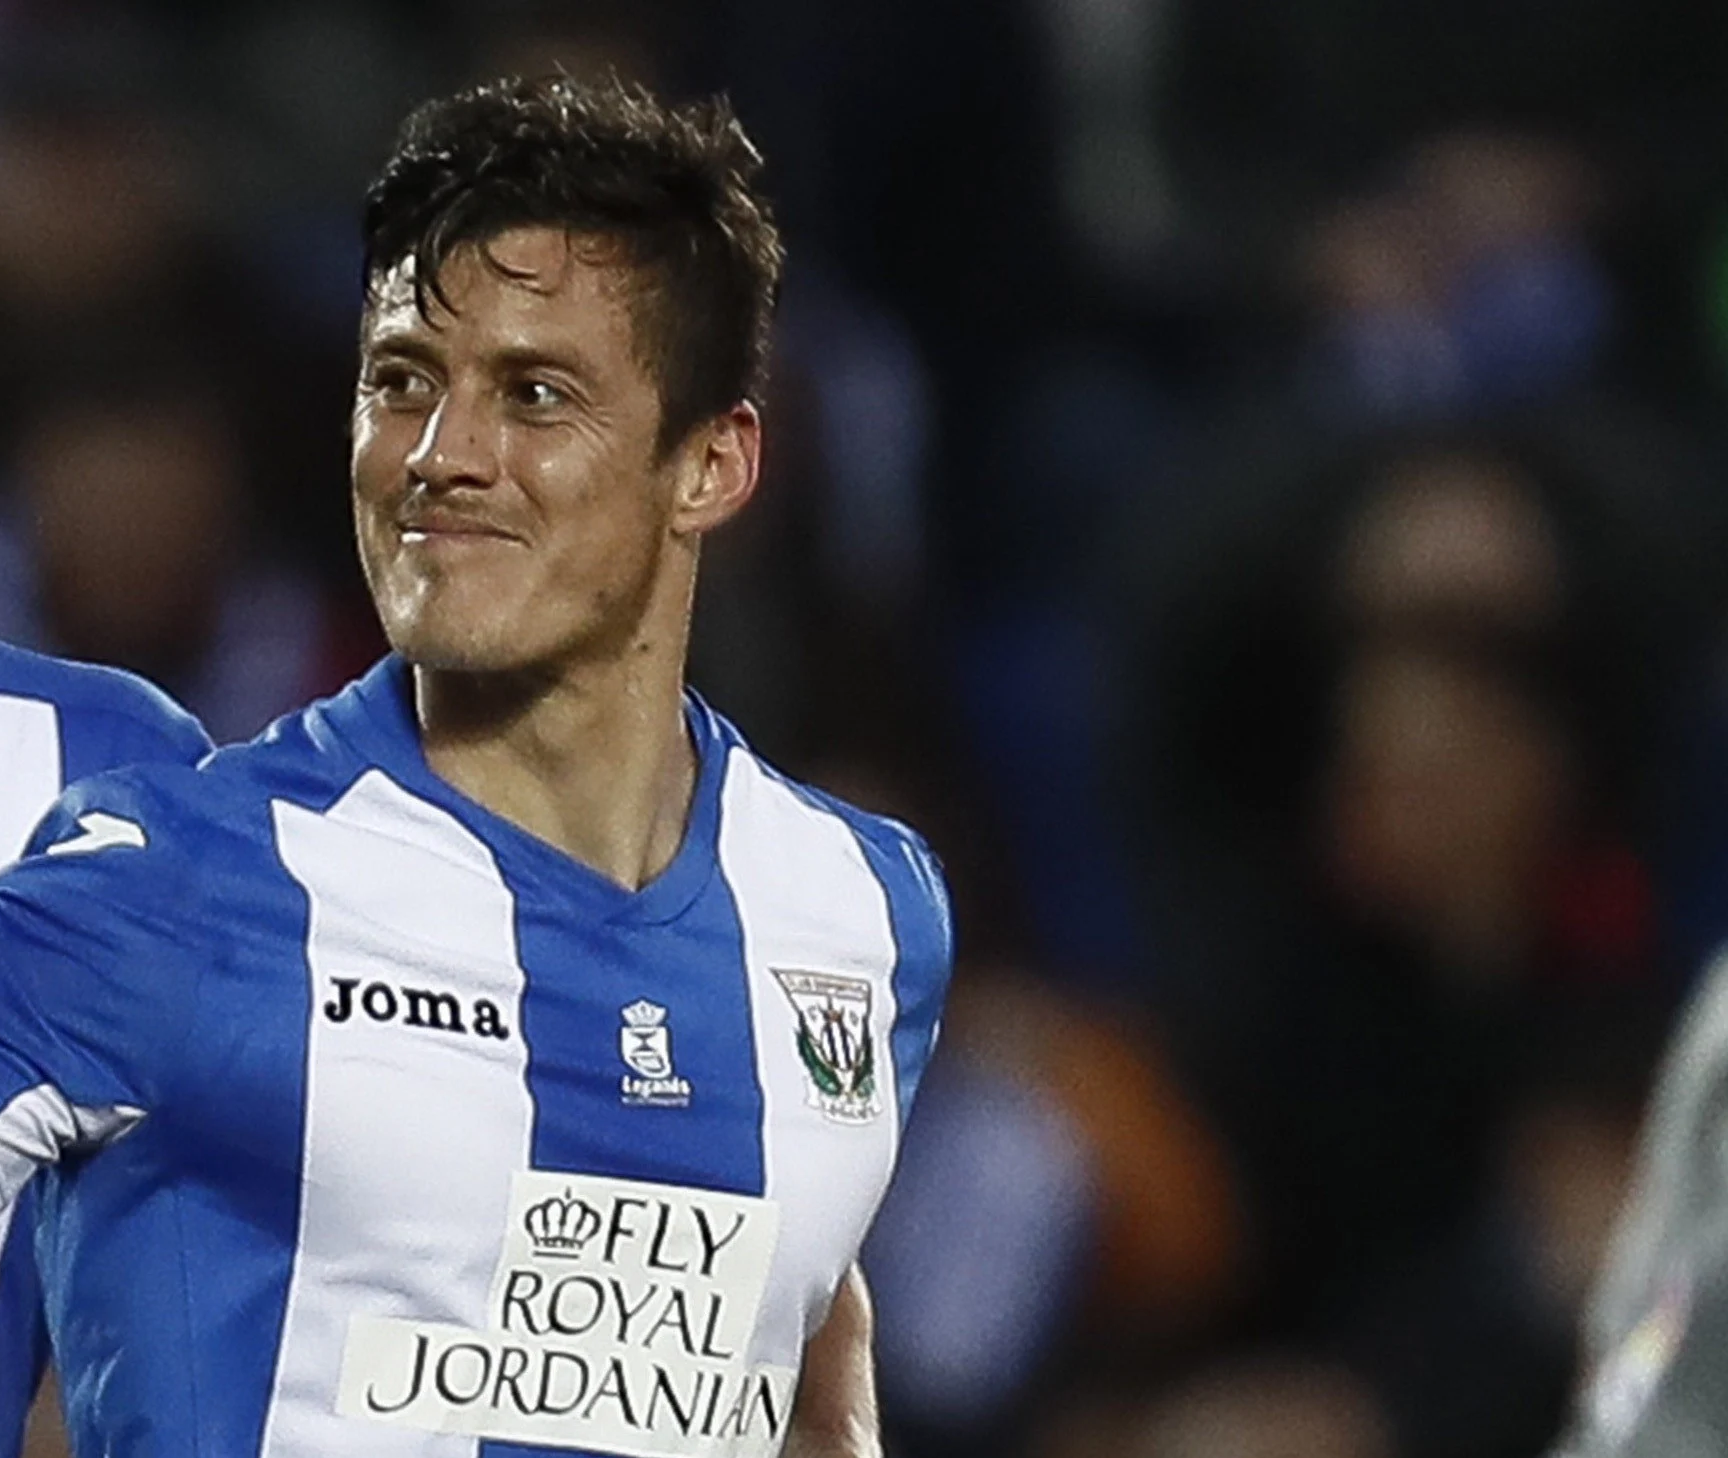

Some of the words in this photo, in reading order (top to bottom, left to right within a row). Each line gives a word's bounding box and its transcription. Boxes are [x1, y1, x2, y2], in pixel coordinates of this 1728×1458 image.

[324, 976, 510, 1041] Joma
[603, 1196, 745, 1277] FLY
[501, 1270, 733, 1360] ROYAL
[367, 1334, 794, 1440] JORDANIAN
